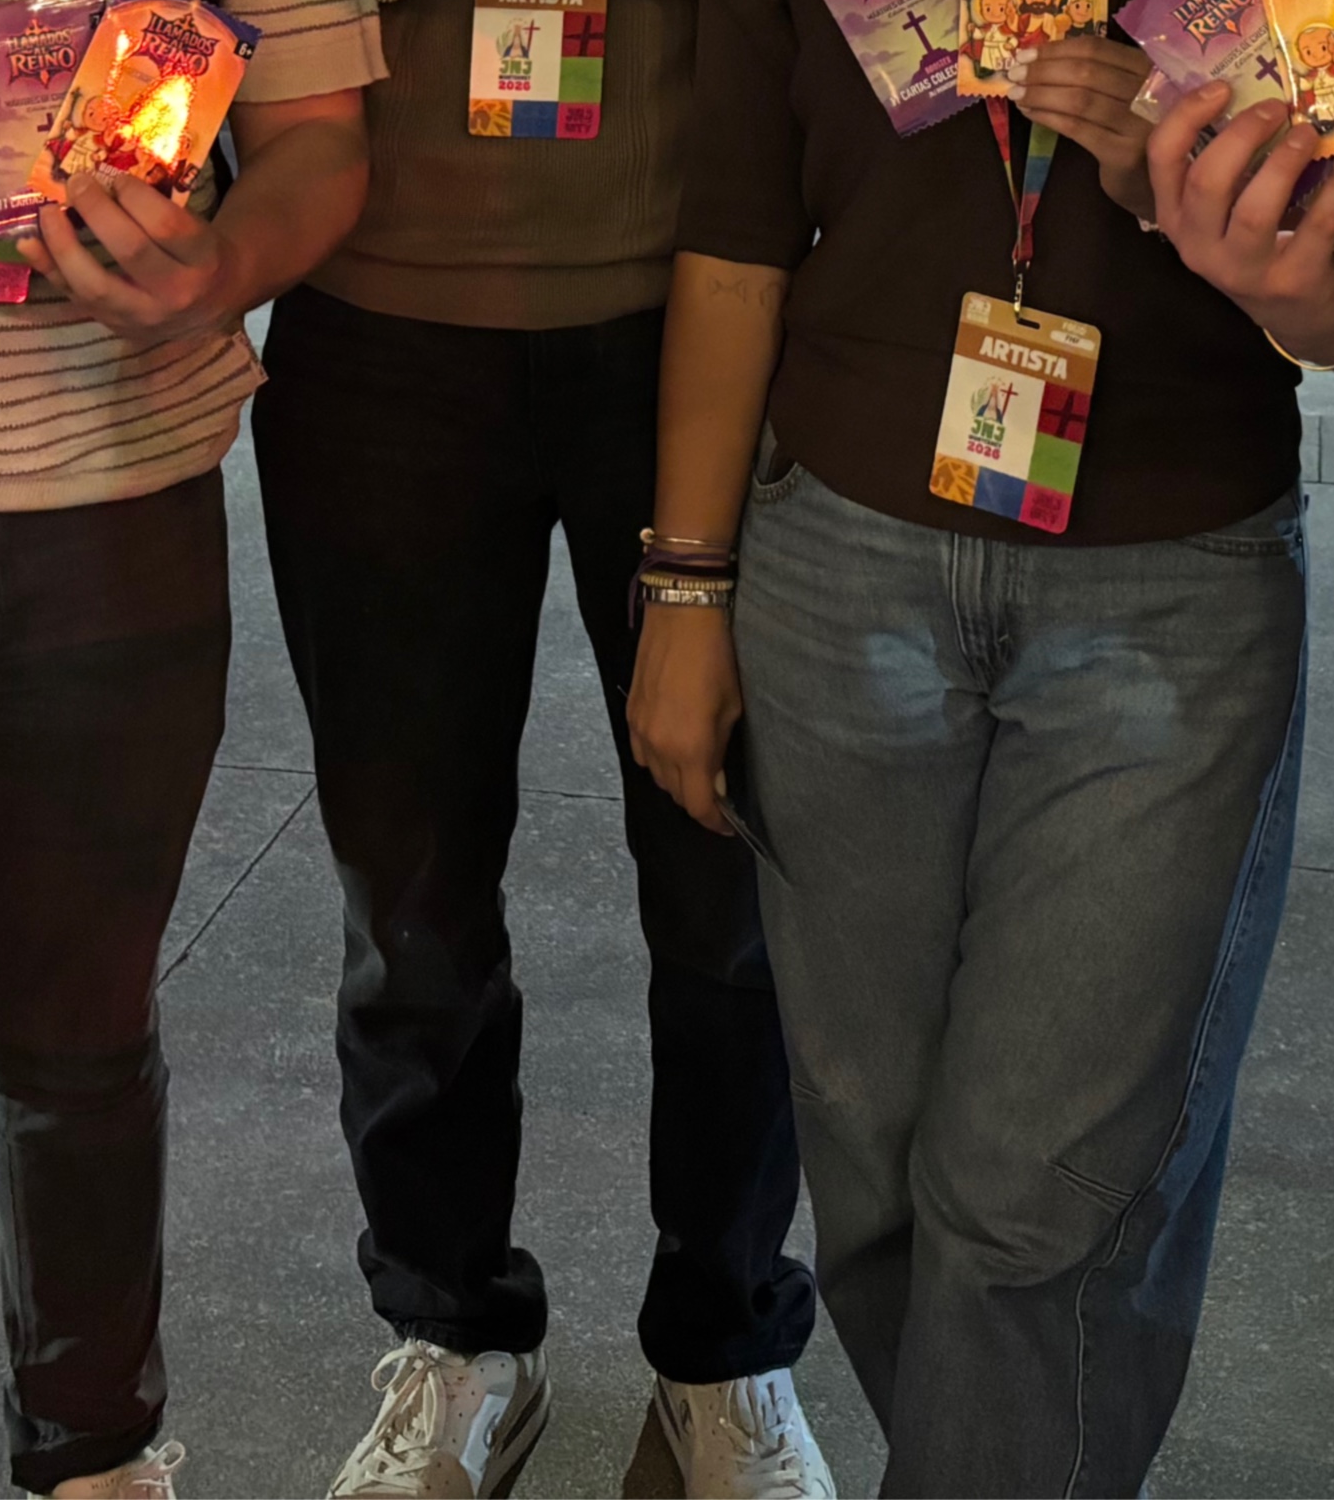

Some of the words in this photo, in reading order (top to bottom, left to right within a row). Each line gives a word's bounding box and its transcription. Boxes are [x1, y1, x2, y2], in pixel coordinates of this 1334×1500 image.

[7, 28, 72, 49] LLAMADOS
[149, 13, 216, 54] LLAMADOS
[238, 42, 253, 58] 6+
[10, 47, 76, 78] REINO
[498, 81, 532, 92] 2026
[899, 78, 932, 101] CARTAS
[979, 335, 1068, 380] ARTISTA
[967, 441, 1001, 460] 2026
